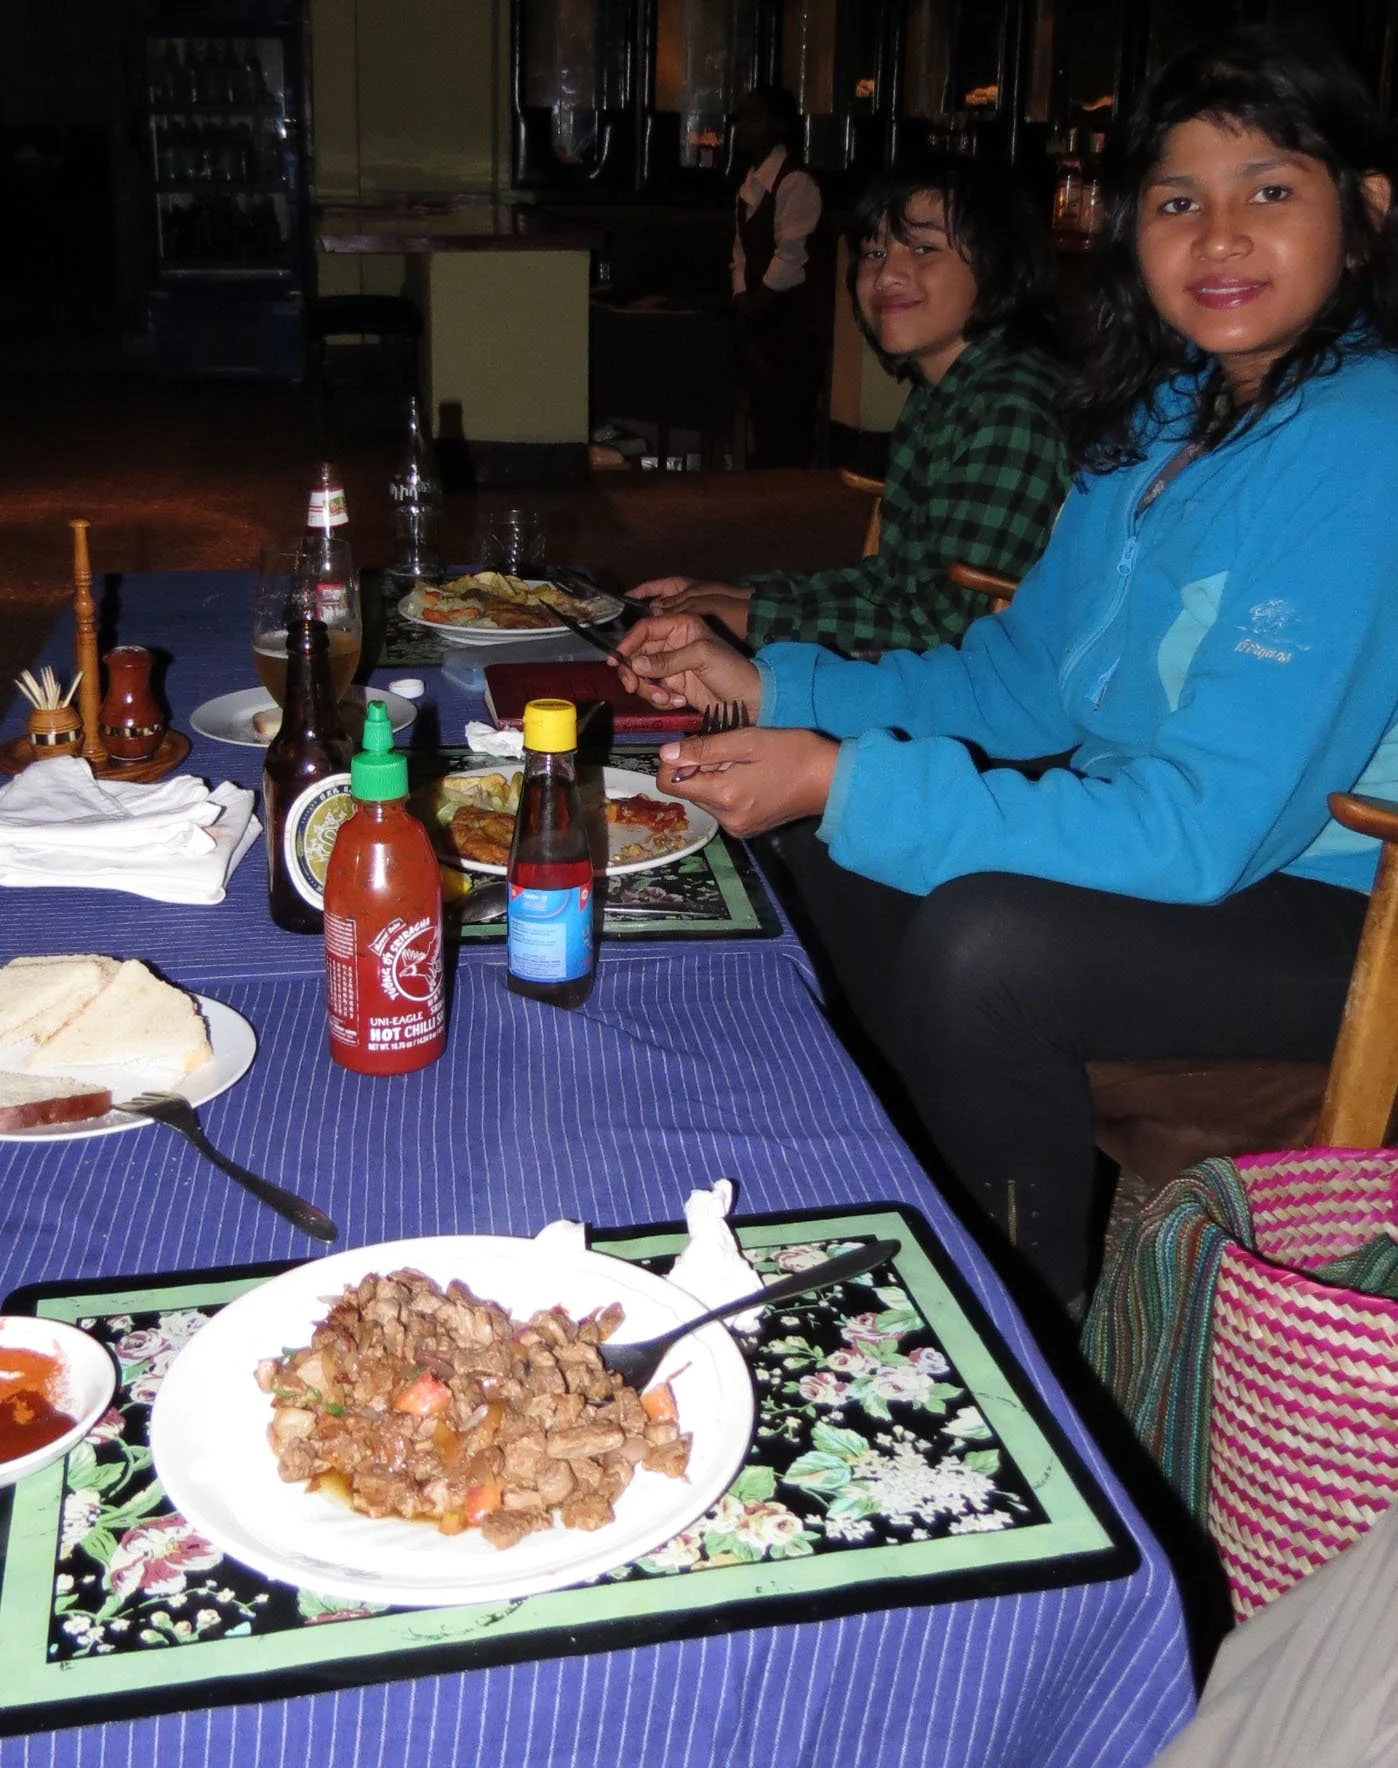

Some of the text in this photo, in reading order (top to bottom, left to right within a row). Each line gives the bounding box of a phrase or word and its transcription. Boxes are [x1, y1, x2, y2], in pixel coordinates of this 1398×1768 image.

[390, 917, 431, 953] SRIRACHA
[370, 1011, 424, 1026] UNI-EAGLE
[370, 1027, 401, 1041] HOT
[404, 1016, 436, 1038] CHILLI
